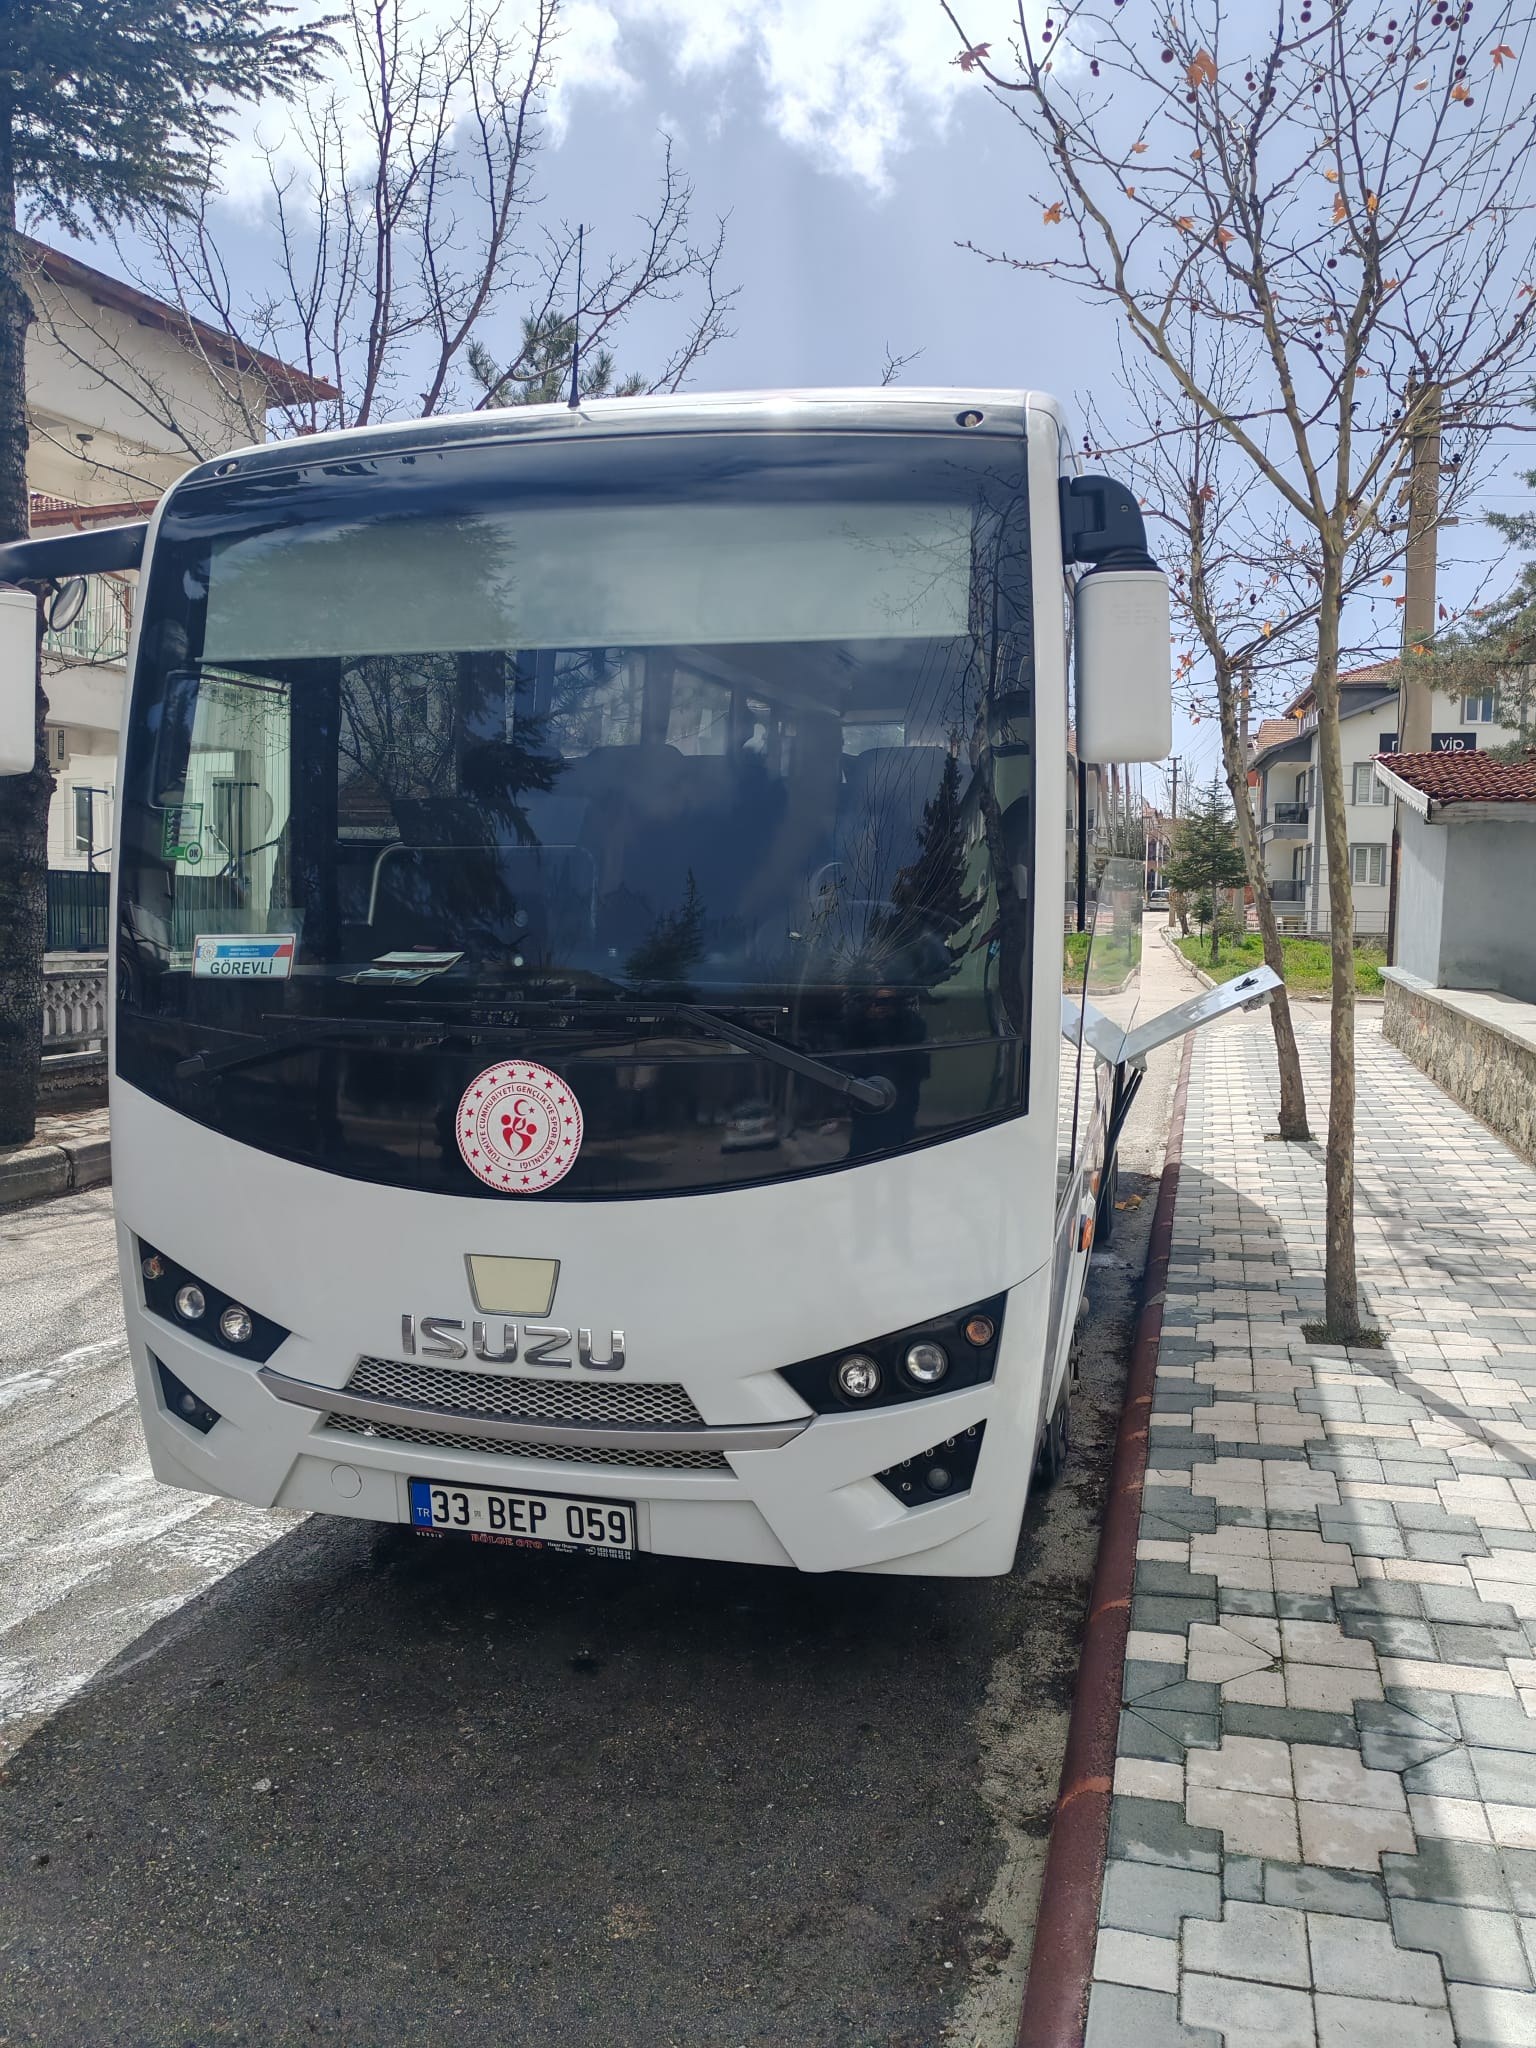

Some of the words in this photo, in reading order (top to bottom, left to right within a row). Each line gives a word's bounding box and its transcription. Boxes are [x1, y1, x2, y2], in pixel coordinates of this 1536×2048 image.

[1440, 737, 1465, 752] vip
[189, 848, 199, 858] OK
[210, 958, 274, 975] GÖREVLİ
[516, 1085, 548, 1104] GENÇLİK
[480, 1085, 514, 1129] CUMHURİYETİ
[546, 1103, 555, 1114] VE
[550, 1116, 558, 1139] SPOR
[480, 1131, 501, 1162] TÜRKİYE
[519, 1140, 556, 1169] BAKANLIĞI
[402, 1313, 625, 1371] ISUZU
[416, 1507, 431, 1518] TR
[431, 1490, 470, 1525] 33
[487, 1496, 547, 1533] BEP
[566, 1505, 626, 1544] 059
